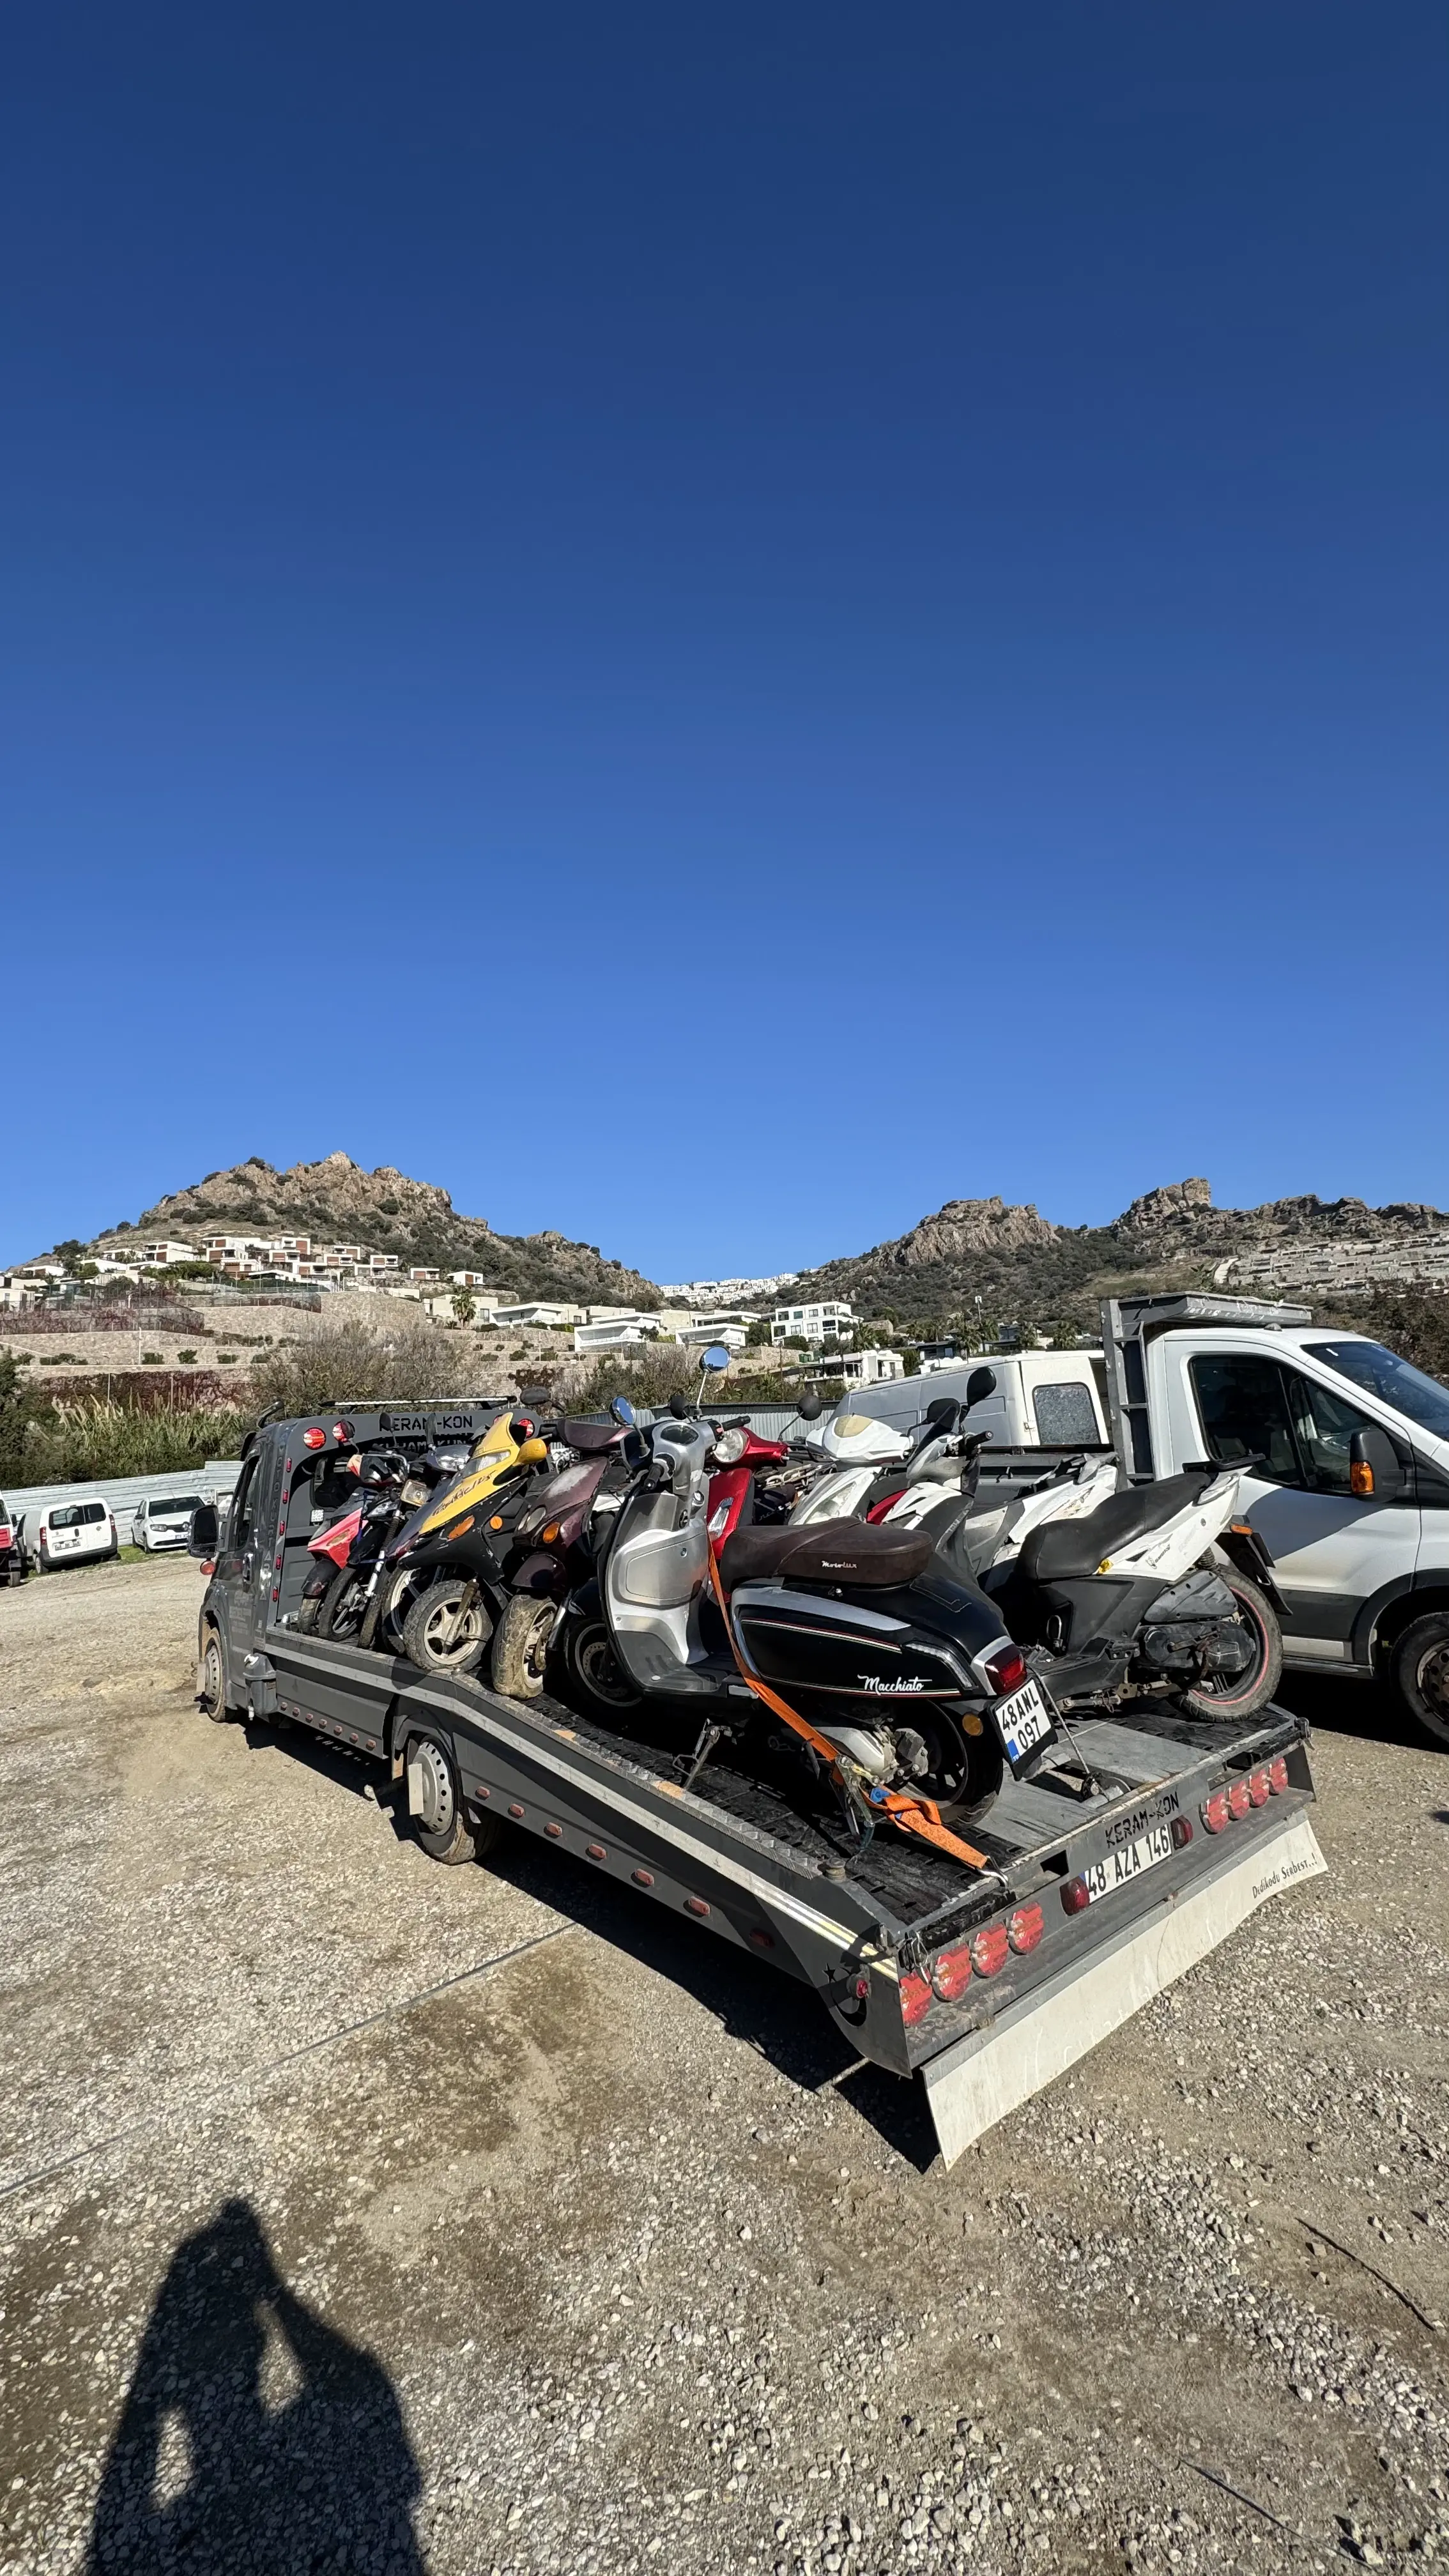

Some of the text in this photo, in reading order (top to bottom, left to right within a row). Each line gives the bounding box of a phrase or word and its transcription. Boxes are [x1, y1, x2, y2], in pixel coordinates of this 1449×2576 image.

[379, 1415, 473, 1432] ERA-KON
[259, 1498, 279, 1600] KURTARA
[857, 1674, 932, 1696] Macchiato
[1002, 1687, 1039, 1730] 48ANL
[1018, 1715, 1041, 1750] 097
[1105, 1791, 1180, 1848] KERAM-KON
[1087, 1825, 1169, 1896] 48 AZA 146
